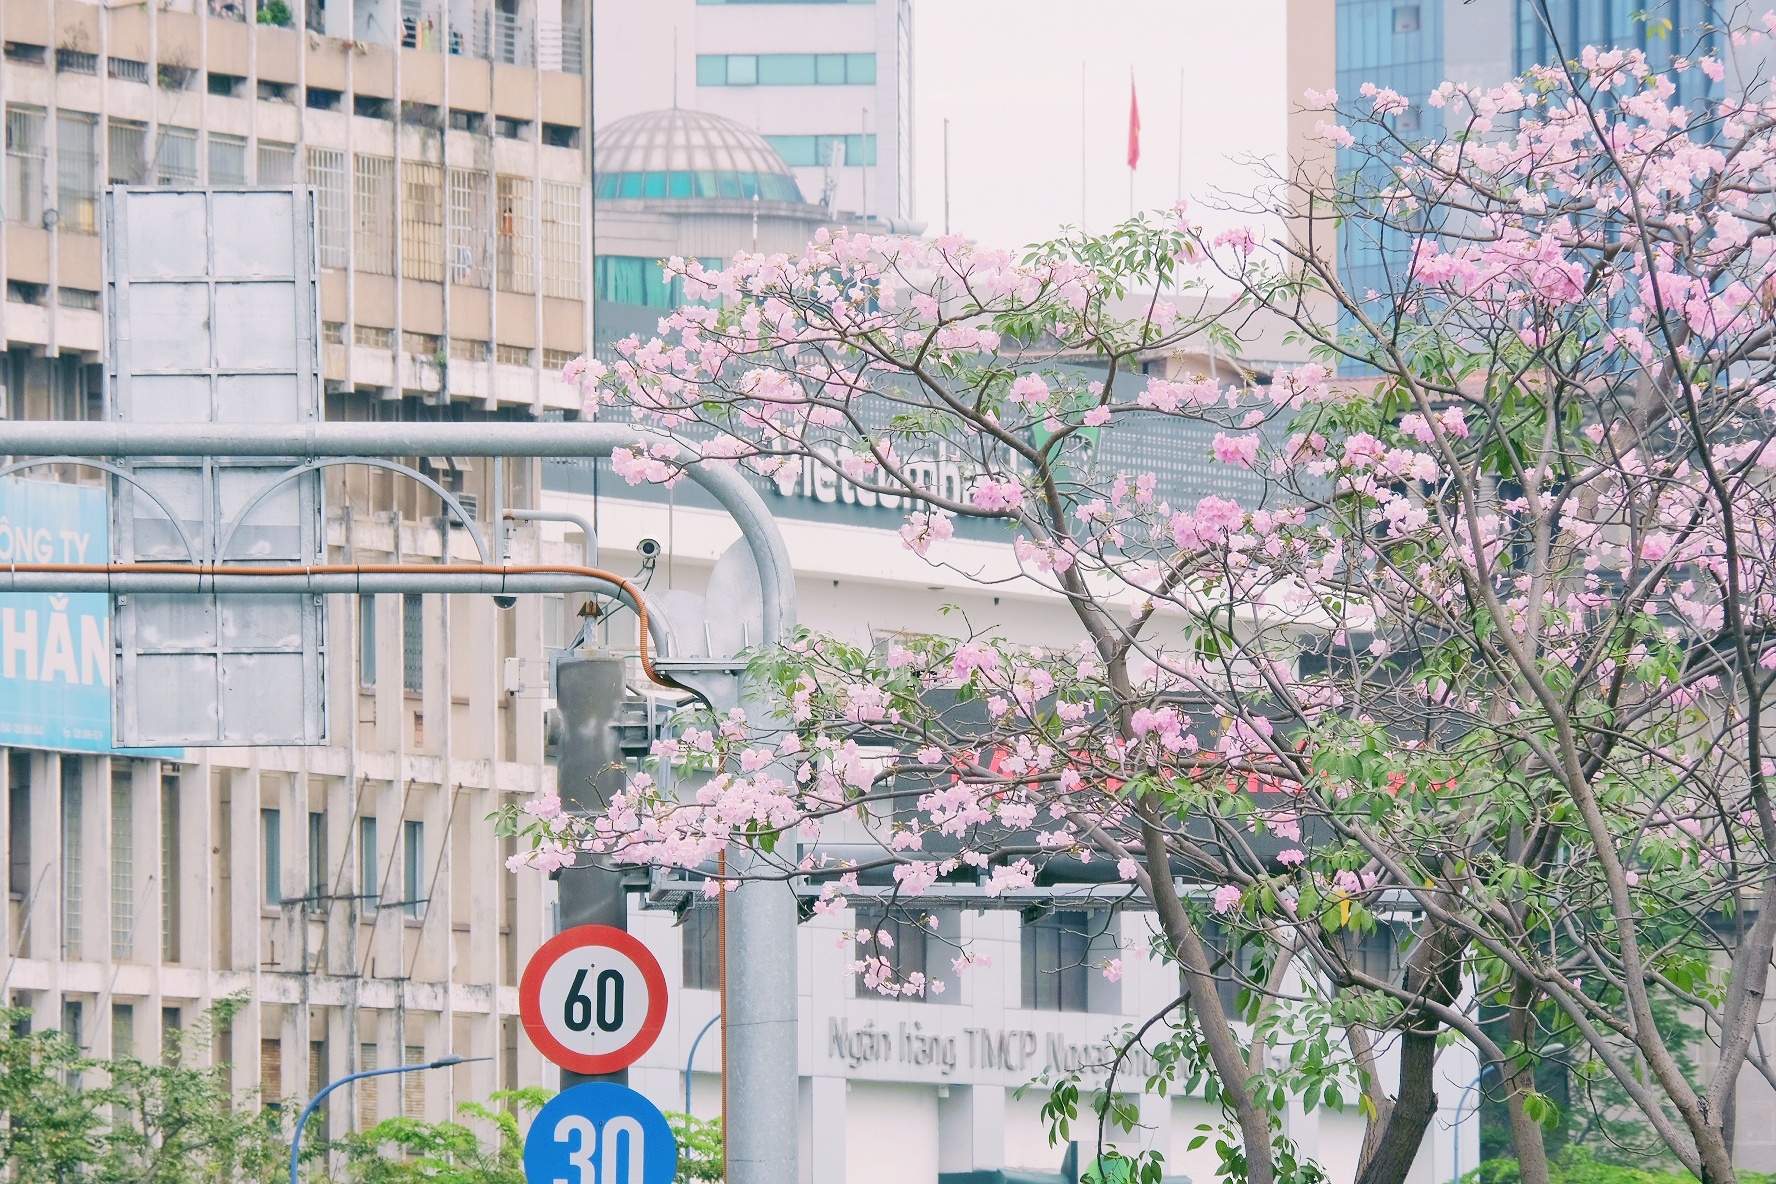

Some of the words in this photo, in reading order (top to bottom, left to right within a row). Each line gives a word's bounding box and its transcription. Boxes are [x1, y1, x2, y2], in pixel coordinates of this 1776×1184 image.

[59, 530, 90, 564] TY
[564, 969, 624, 1032] 60
[828, 1016, 891, 1068] Ngân
[900, 1020, 956, 1075] hàng
[963, 1027, 1036, 1071] TMCP
[553, 1114, 645, 1184] 30
